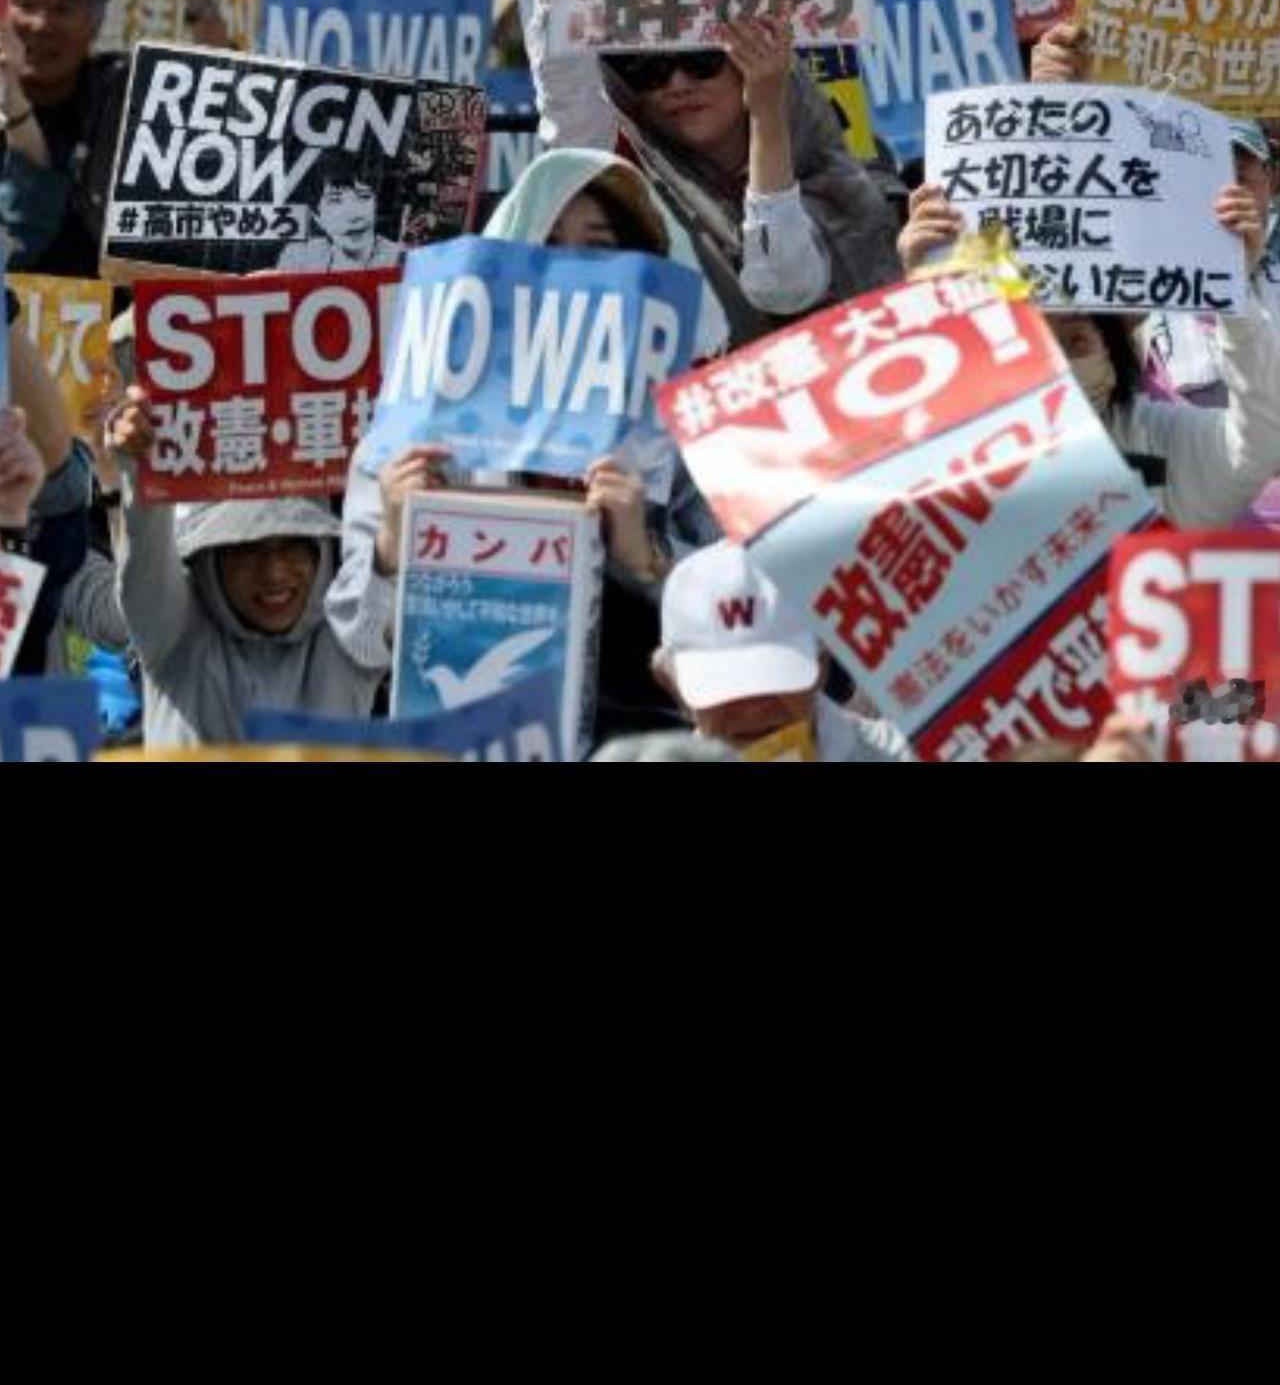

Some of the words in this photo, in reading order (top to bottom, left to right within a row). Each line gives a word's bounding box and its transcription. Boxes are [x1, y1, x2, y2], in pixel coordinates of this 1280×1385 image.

[265, 6, 354, 71] NO
[366, 12, 482, 89] WAR
[142, 60, 412, 158] RESIGN
[946, 97, 1112, 143] あなたの
[123, 125, 322, 204] NOW
[943, 153, 1162, 198] 大切な人を
[117, 205, 300, 239] #高市やめろ
[382, 275, 492, 405] NO
[509, 285, 679, 418] WAR
[717, 595, 755, 629] W
